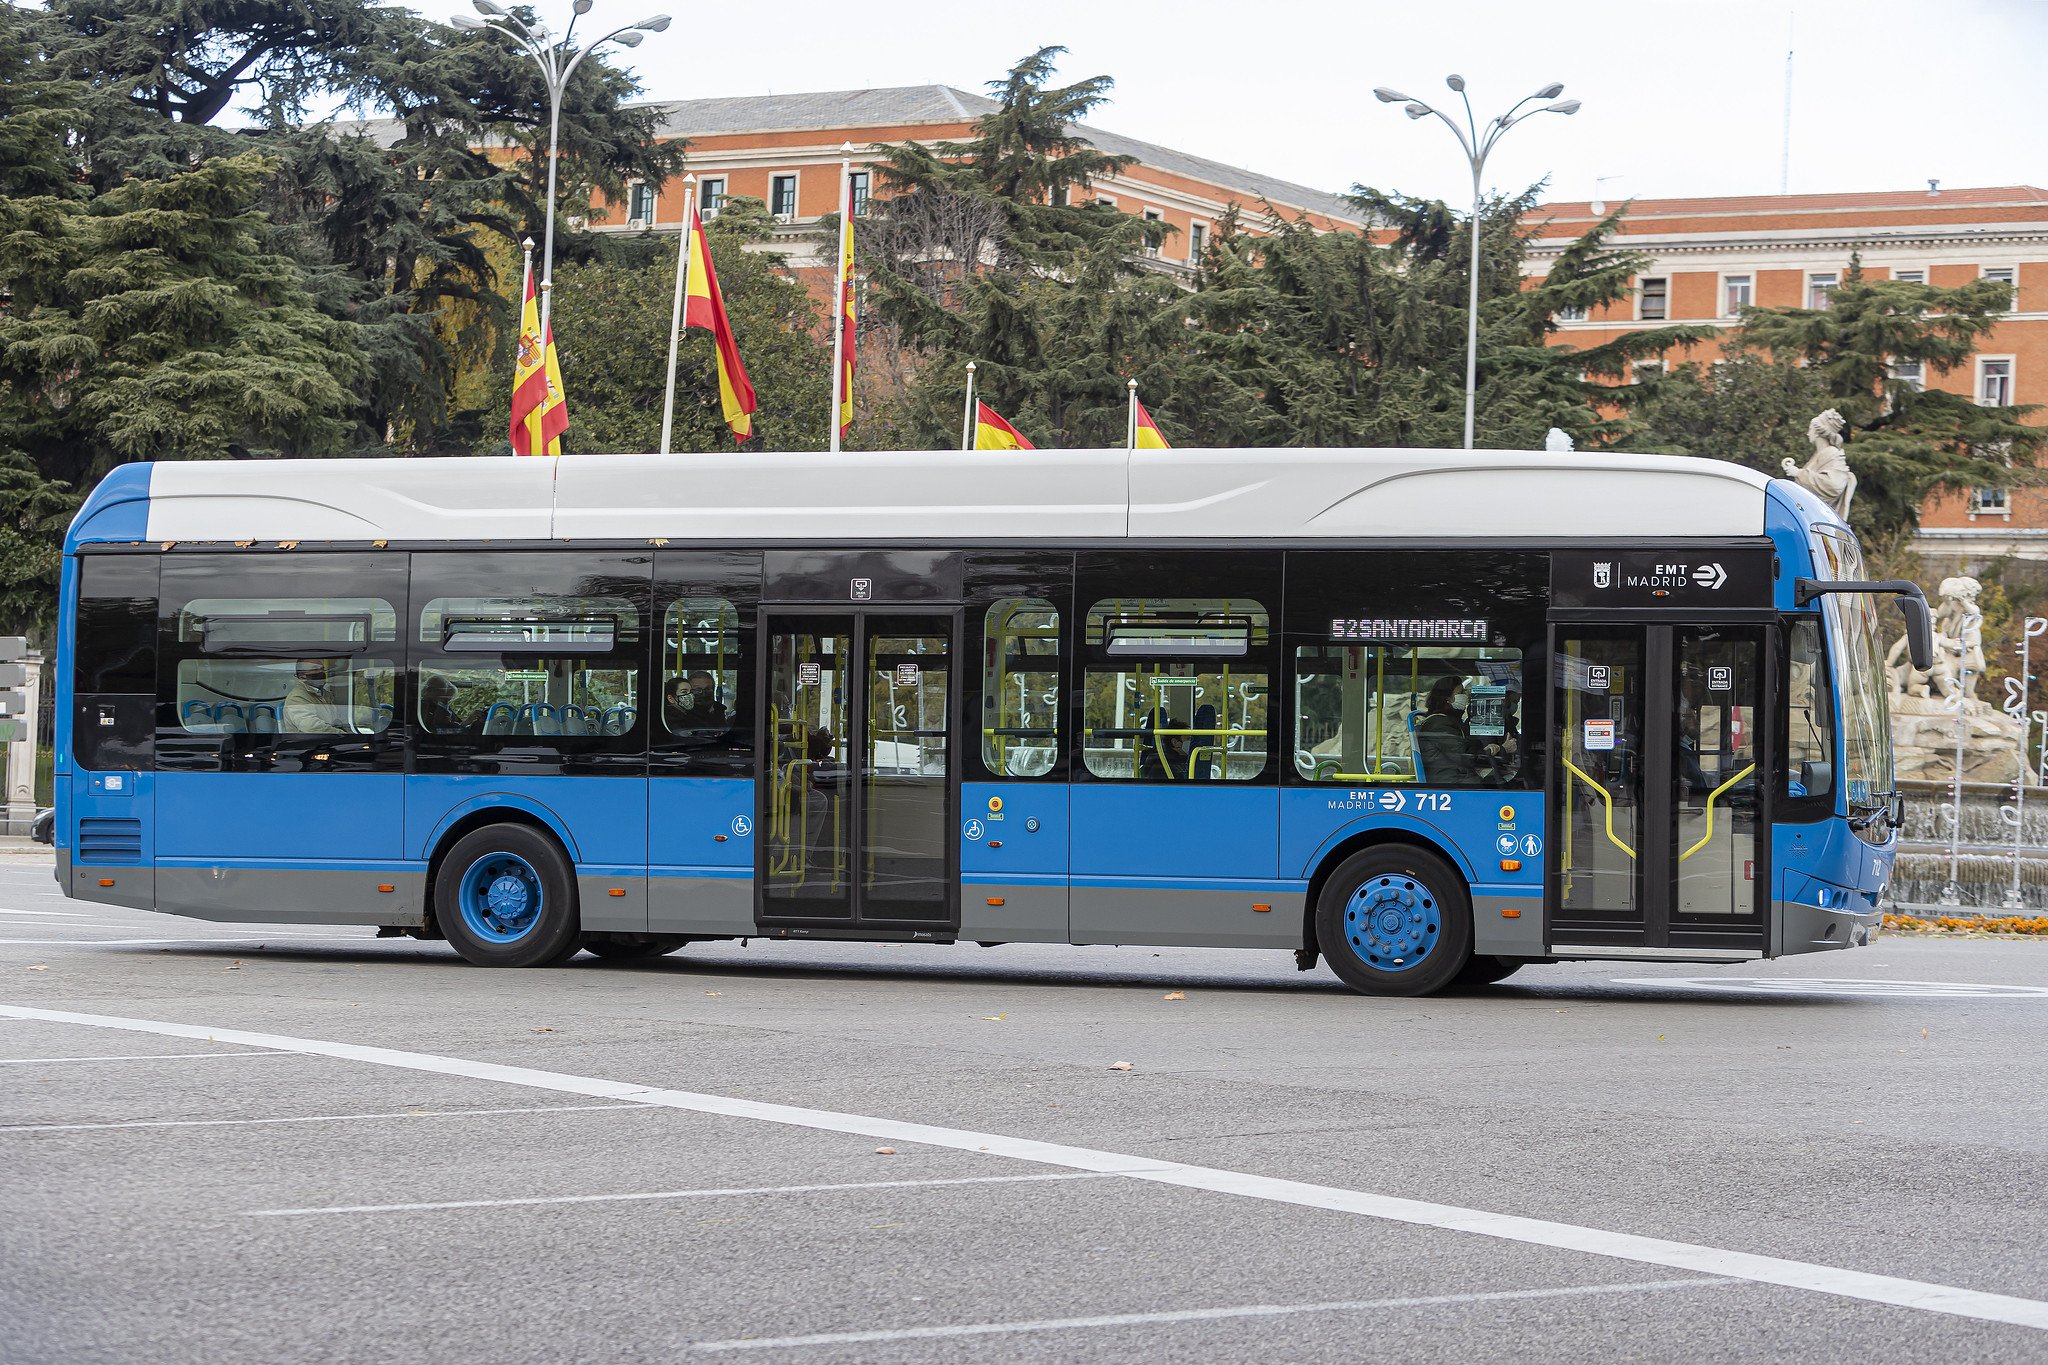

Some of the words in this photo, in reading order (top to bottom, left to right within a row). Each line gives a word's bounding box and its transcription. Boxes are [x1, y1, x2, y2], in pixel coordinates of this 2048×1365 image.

[1655, 564, 1687, 575] EMT
[1627, 576, 1687, 587] MADRID
[1350, 791, 1375, 800] EMT
[1328, 801, 1375, 810] MADRID
[1415, 793, 1452, 811] 712
